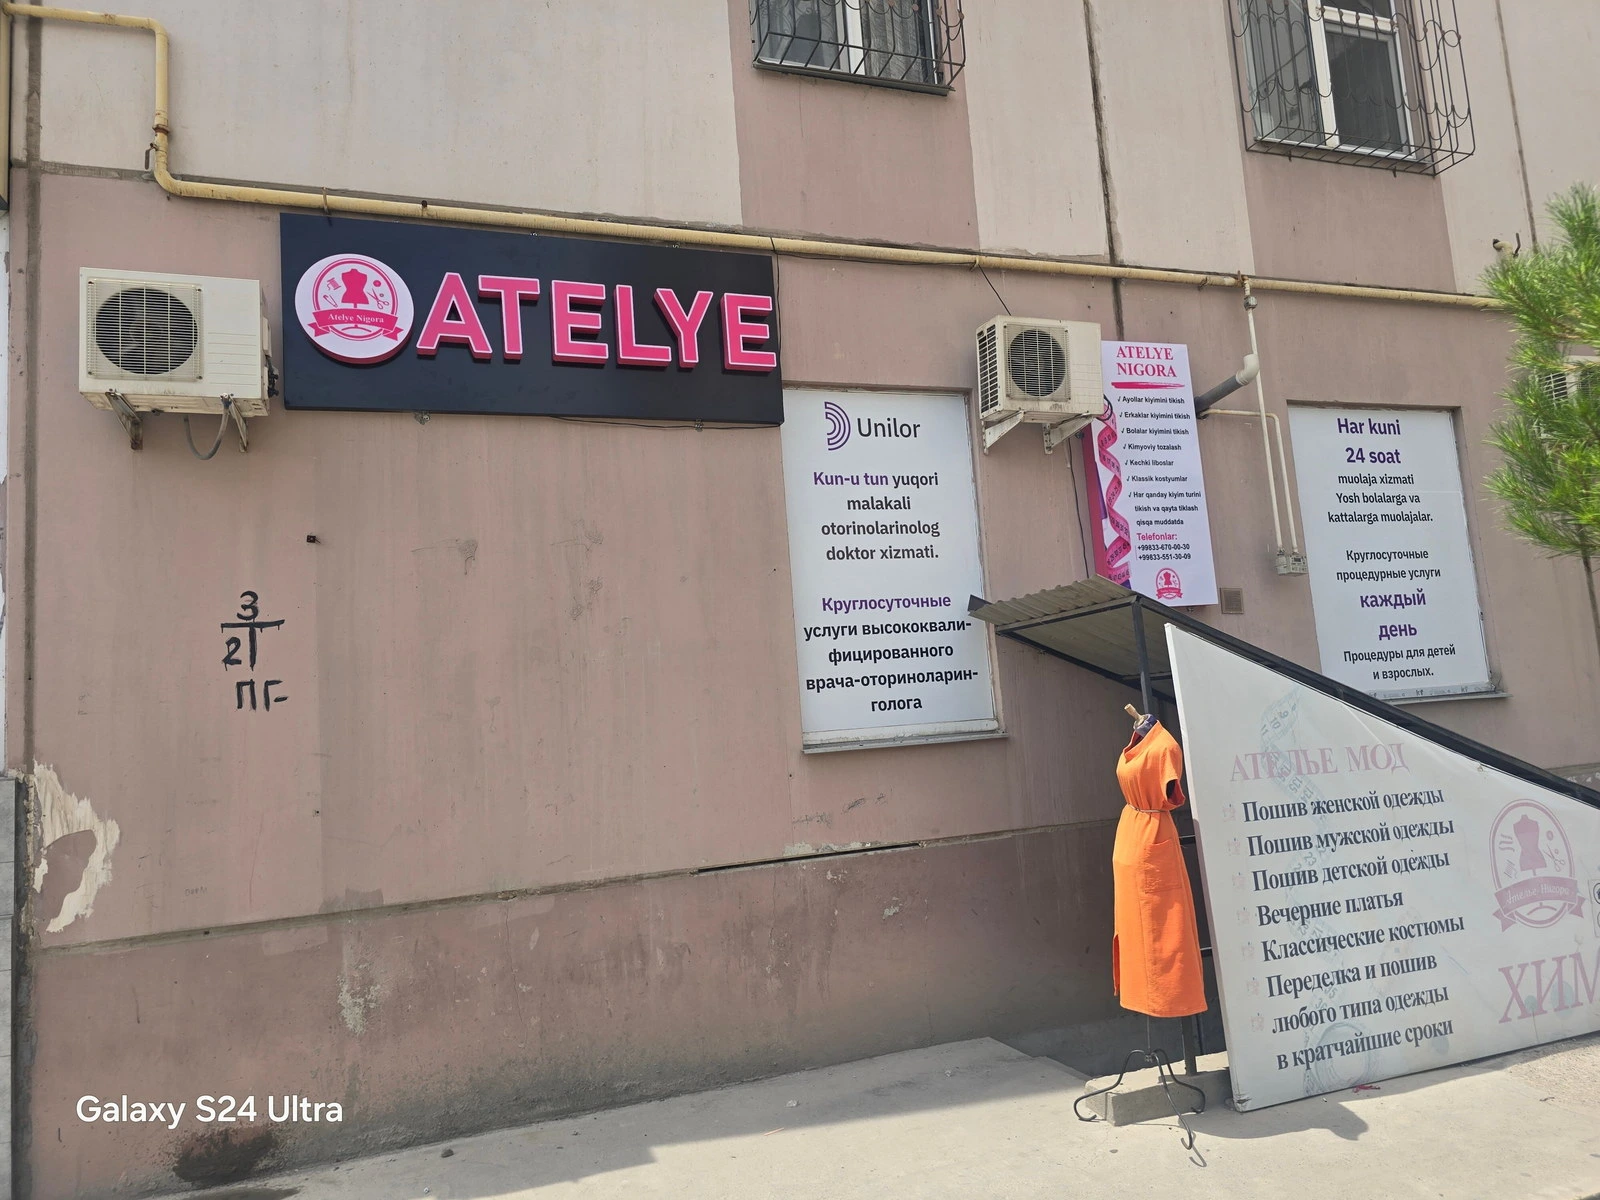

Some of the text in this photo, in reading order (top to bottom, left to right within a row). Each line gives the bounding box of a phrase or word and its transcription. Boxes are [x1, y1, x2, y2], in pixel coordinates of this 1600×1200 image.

[328, 313, 384, 324] Atelye Nigora
[416, 271, 777, 371] ATELYE
[1116, 345, 1174, 361] ATELYE
[1116, 362, 1178, 378] NIGORA
[1122, 396, 1185, 405] Ayollar kiyimini tikish
[1150, 412, 1174, 420] kiyimini
[1174, 412, 1191, 420] tikish
[857, 417, 921, 438] Unilor
[1148, 428, 1172, 436] kiyimini
[1337, 418, 1401, 435] Har kuni
[1128, 444, 1156, 452] Kimyoviy
[1345, 447, 1402, 464] 24 soat
[813, 472, 939, 489] Kun-u tun yuqori
[1338, 473, 1414, 486] muolaja xizmati
[847, 496, 911, 510] malakali
[1336, 492, 1421, 506] Yosh bolalarga va
[1328, 511, 1433, 525] kattalarga muolajalar.
[821, 520, 940, 537] otorinolarinolog
[1136, 533, 1178, 541] Telefonlar:
[826, 545, 939, 560] doktor xizmati.
[1346, 550, 1429, 563] Круглосуточные
[1336, 568, 1441, 583] процедурные услуги
[237, 590, 259, 621] 3
[822, 596, 951, 614] Круглосуточные
[1360, 588, 1426, 609] каждый
[804, 620, 972, 641] услуги высококвали-
[1378, 624, 1418, 641] день
[222, 636, 242, 666] 2
[828, 645, 954, 666] фицированного
[1344, 644, 1456, 664] Процедуры для детей
[806, 668, 978, 693] врача-оториноларин-
[1373, 667, 1434, 681] и взрослых.
[871, 698, 922, 712] голога
[1230, 747, 1338, 782] АТЕЛЬЕ
[1345, 743, 1411, 774] МОД
[1242, 788, 1445, 823] Пошив женской одежды
[1247, 820, 1455, 857] Пошив мужской одежды
[1252, 852, 1450, 891] Пошив детской одежды
[1257, 892, 1404, 927] Вечерние платья
[1261, 928, 1385, 962] Классические
[1388, 916, 1465, 942] костюмы
[1266, 964, 1361, 1000] Переделка
[1365, 964, 1376, 980] и
[1380, 955, 1438, 978] пошив
[1272, 986, 1449, 1035] любого типа одежды
[1277, 1020, 1454, 1070] в кратчайшие сроки
